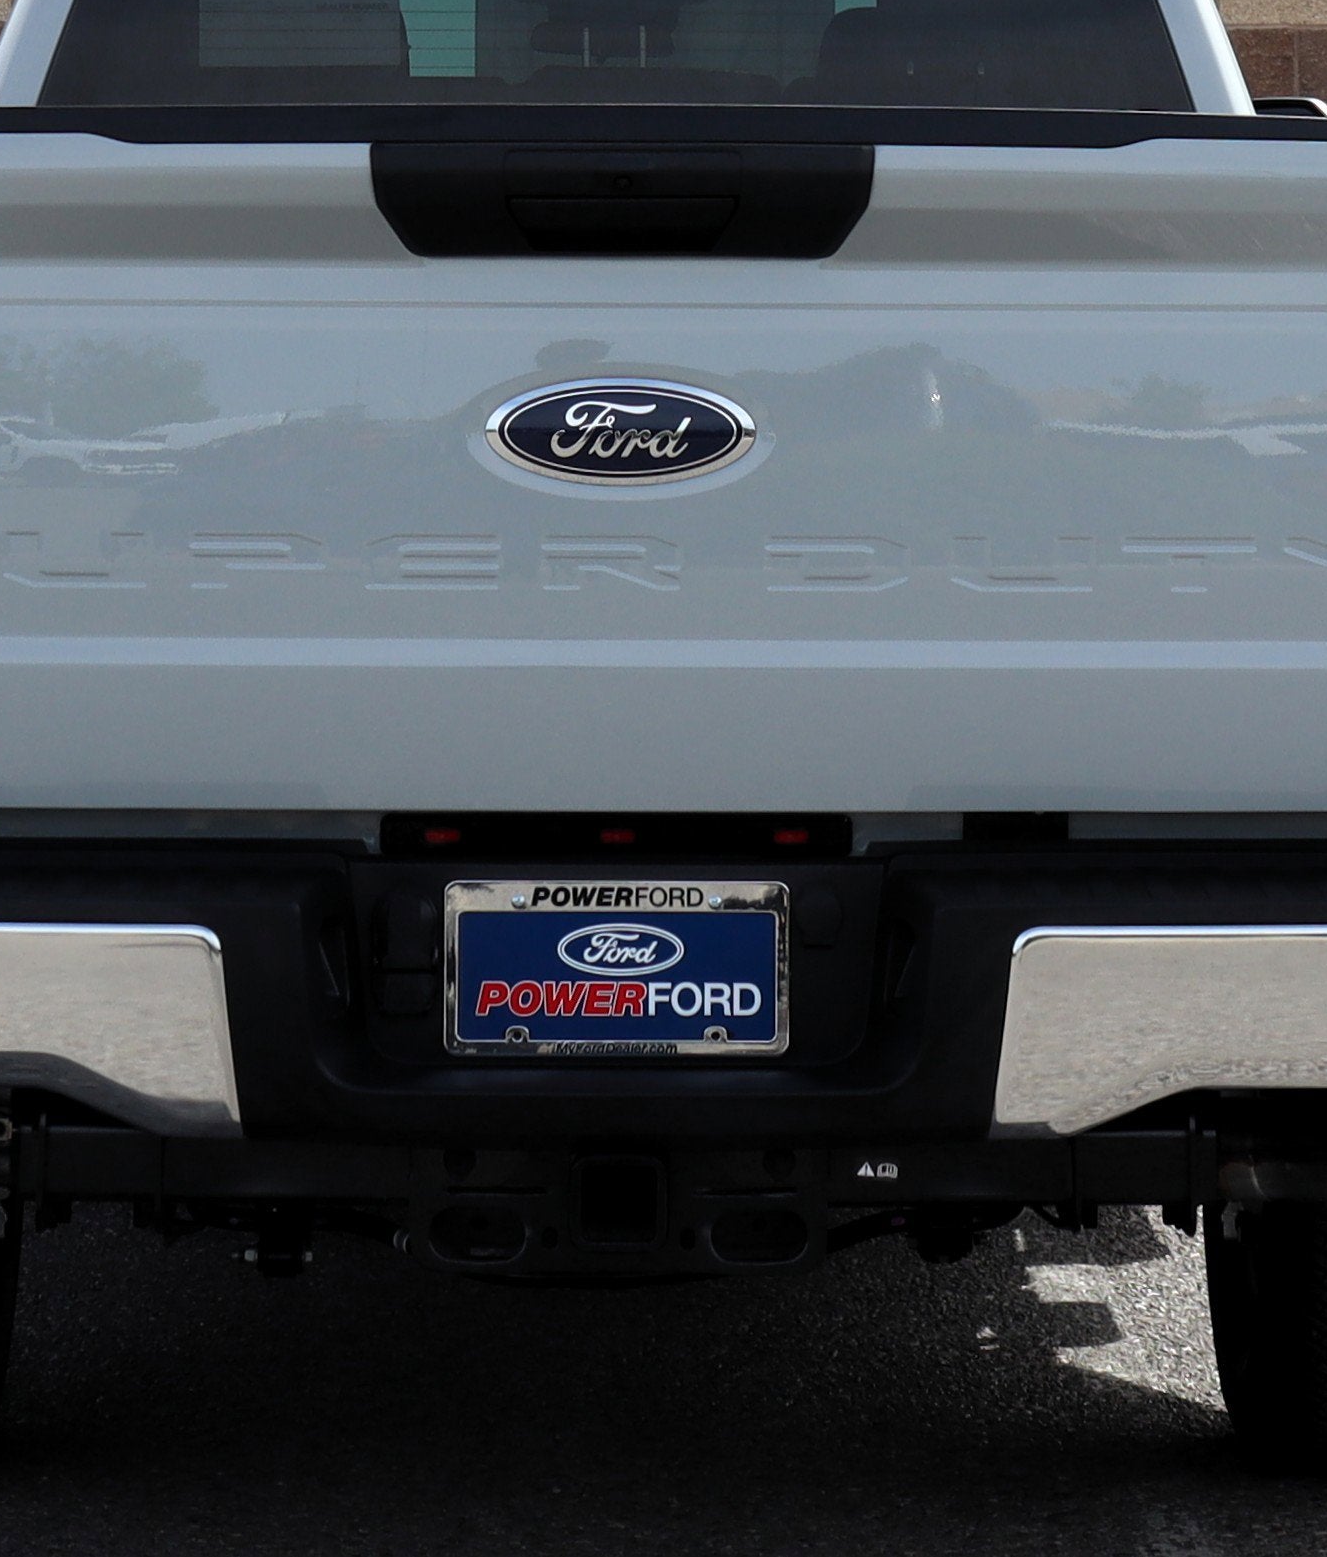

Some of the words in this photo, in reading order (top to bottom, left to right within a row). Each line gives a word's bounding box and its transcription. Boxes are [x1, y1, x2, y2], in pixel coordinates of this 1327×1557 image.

[549, 402, 690, 460] Ford
[531, 886, 705, 908] POWERFORD
[582, 932, 658, 965] Ford
[475, 980, 763, 1017] POWERFORD
